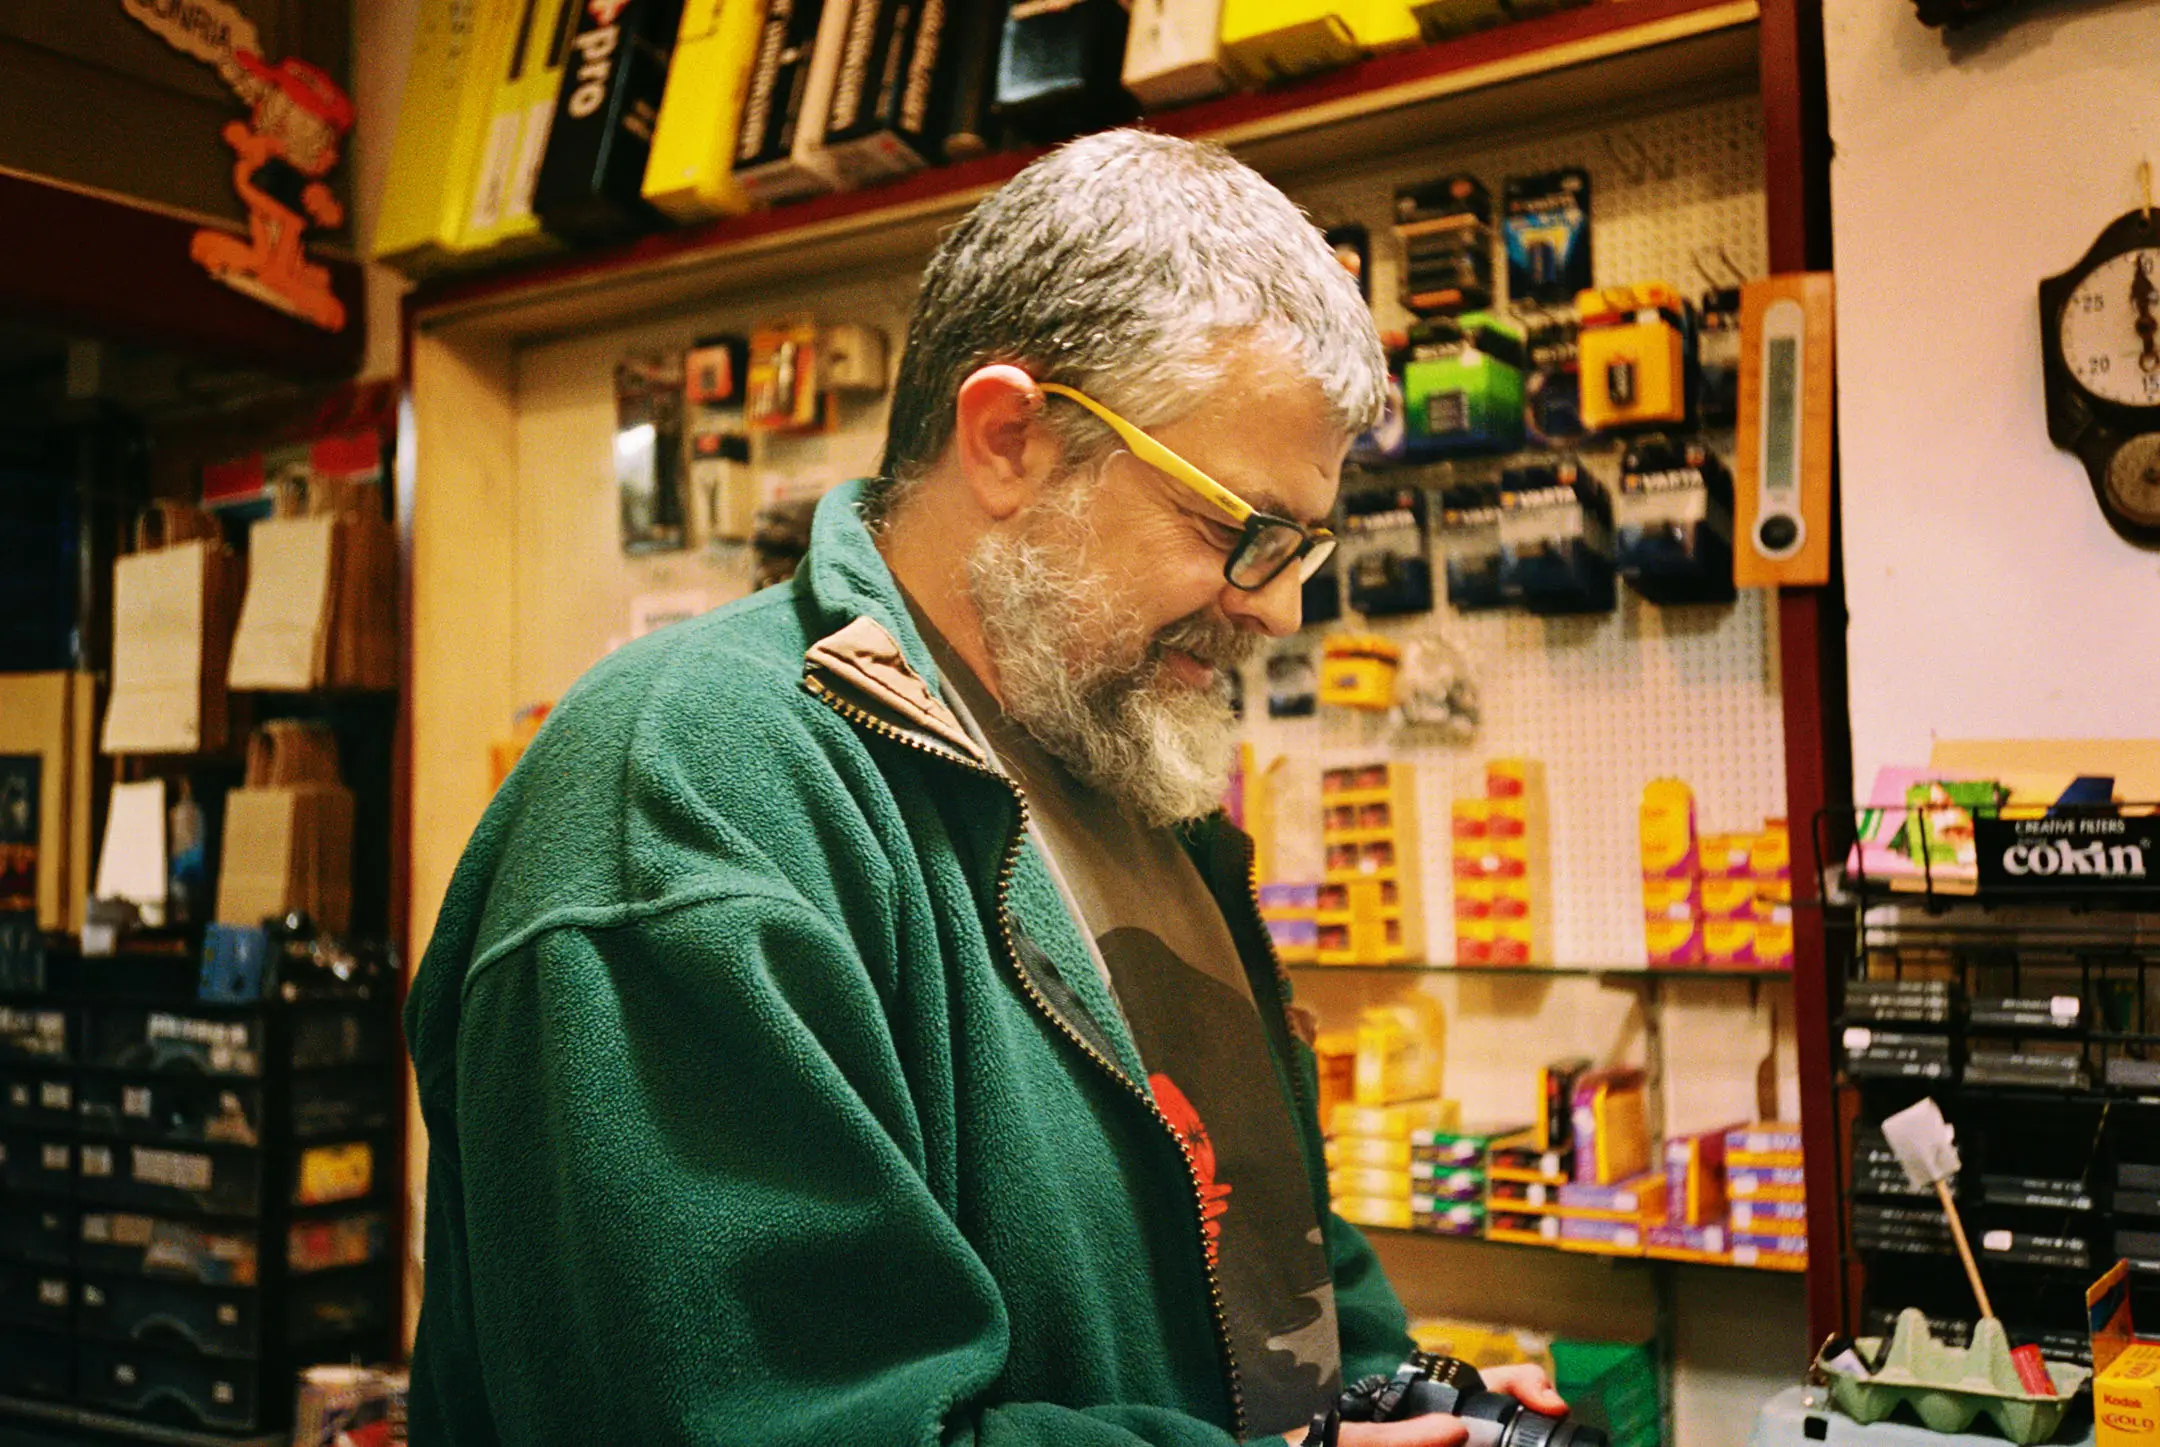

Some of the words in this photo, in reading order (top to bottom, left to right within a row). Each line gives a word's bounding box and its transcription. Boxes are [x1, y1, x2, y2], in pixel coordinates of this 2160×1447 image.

[568, 25, 620, 119] pro
[2082, 294, 2104, 313] 25
[2088, 354, 2110, 374] 20
[2015, 819, 2075, 834] CREATIVE
[2080, 819, 2125, 834] FILTERS
[2003, 839, 2146, 876] cokin
[2103, 1394, 2141, 1408] Kodak
[2104, 1413, 2156, 1433] GOLD
